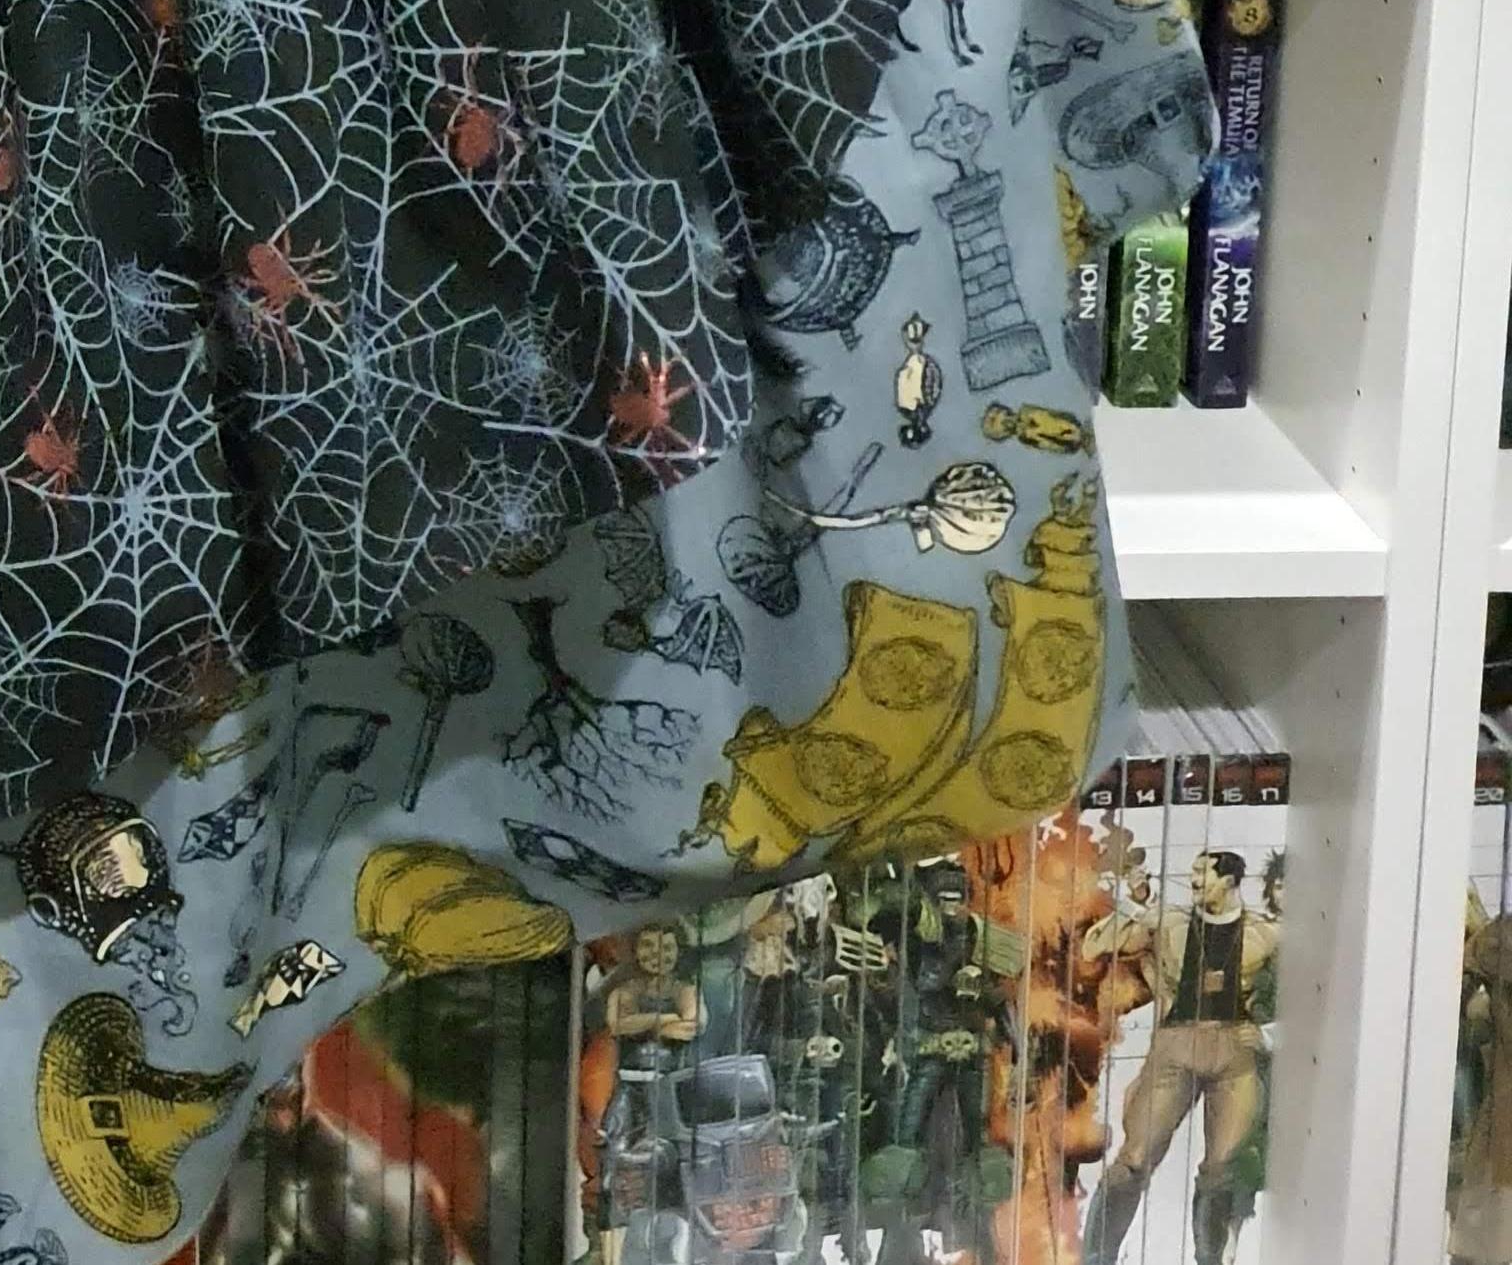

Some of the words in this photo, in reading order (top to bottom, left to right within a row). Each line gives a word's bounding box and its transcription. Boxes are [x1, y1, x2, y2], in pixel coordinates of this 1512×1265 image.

[1230, 46, 1247, 81] THE
[1244, 55, 1263, 125] RETURN
[1242, 128, 1259, 150] OF
[1079, 264, 1098, 318] JOHN
[1131, 238, 1154, 351] FLANAGAN
[1154, 267, 1176, 323] JOHN
[1208, 237, 1232, 352] FLANAGAN
[1231, 267, 1254, 323] JOHN
[1090, 790, 1112, 806] 13
[1136, 788, 1156, 803] 14
[1182, 787, 1202, 802] 15
[1222, 788, 1243, 802] 16
[1260, 788, 1280, 802] 17
